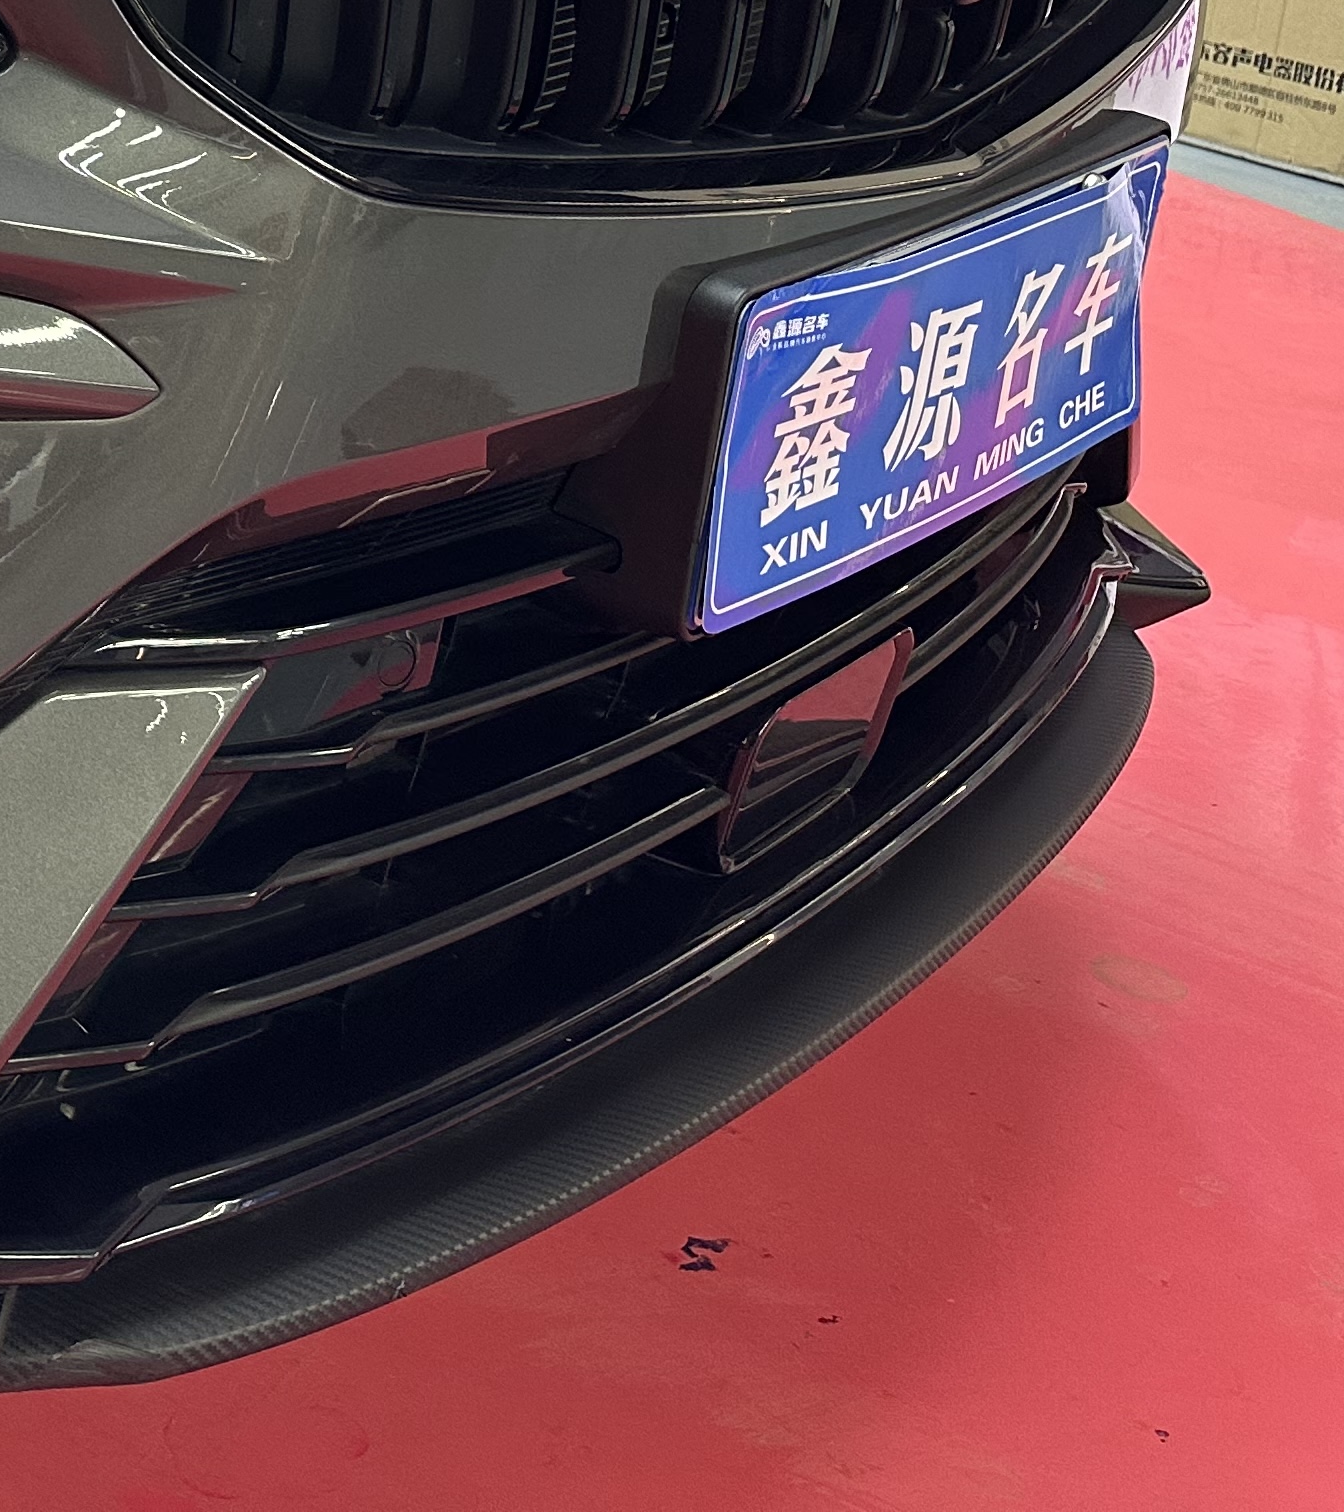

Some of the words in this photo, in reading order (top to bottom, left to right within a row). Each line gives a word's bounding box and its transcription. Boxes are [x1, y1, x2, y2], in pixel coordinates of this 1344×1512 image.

[760, 232, 1134, 529] 鑫源名车
[772, 312, 830, 340] 鑫源名车
[759, 520, 828, 576] XIN
[859, 464, 960, 531] YUAN
[973, 418, 1045, 482] MING
[1058, 381, 1106, 431] CHE
